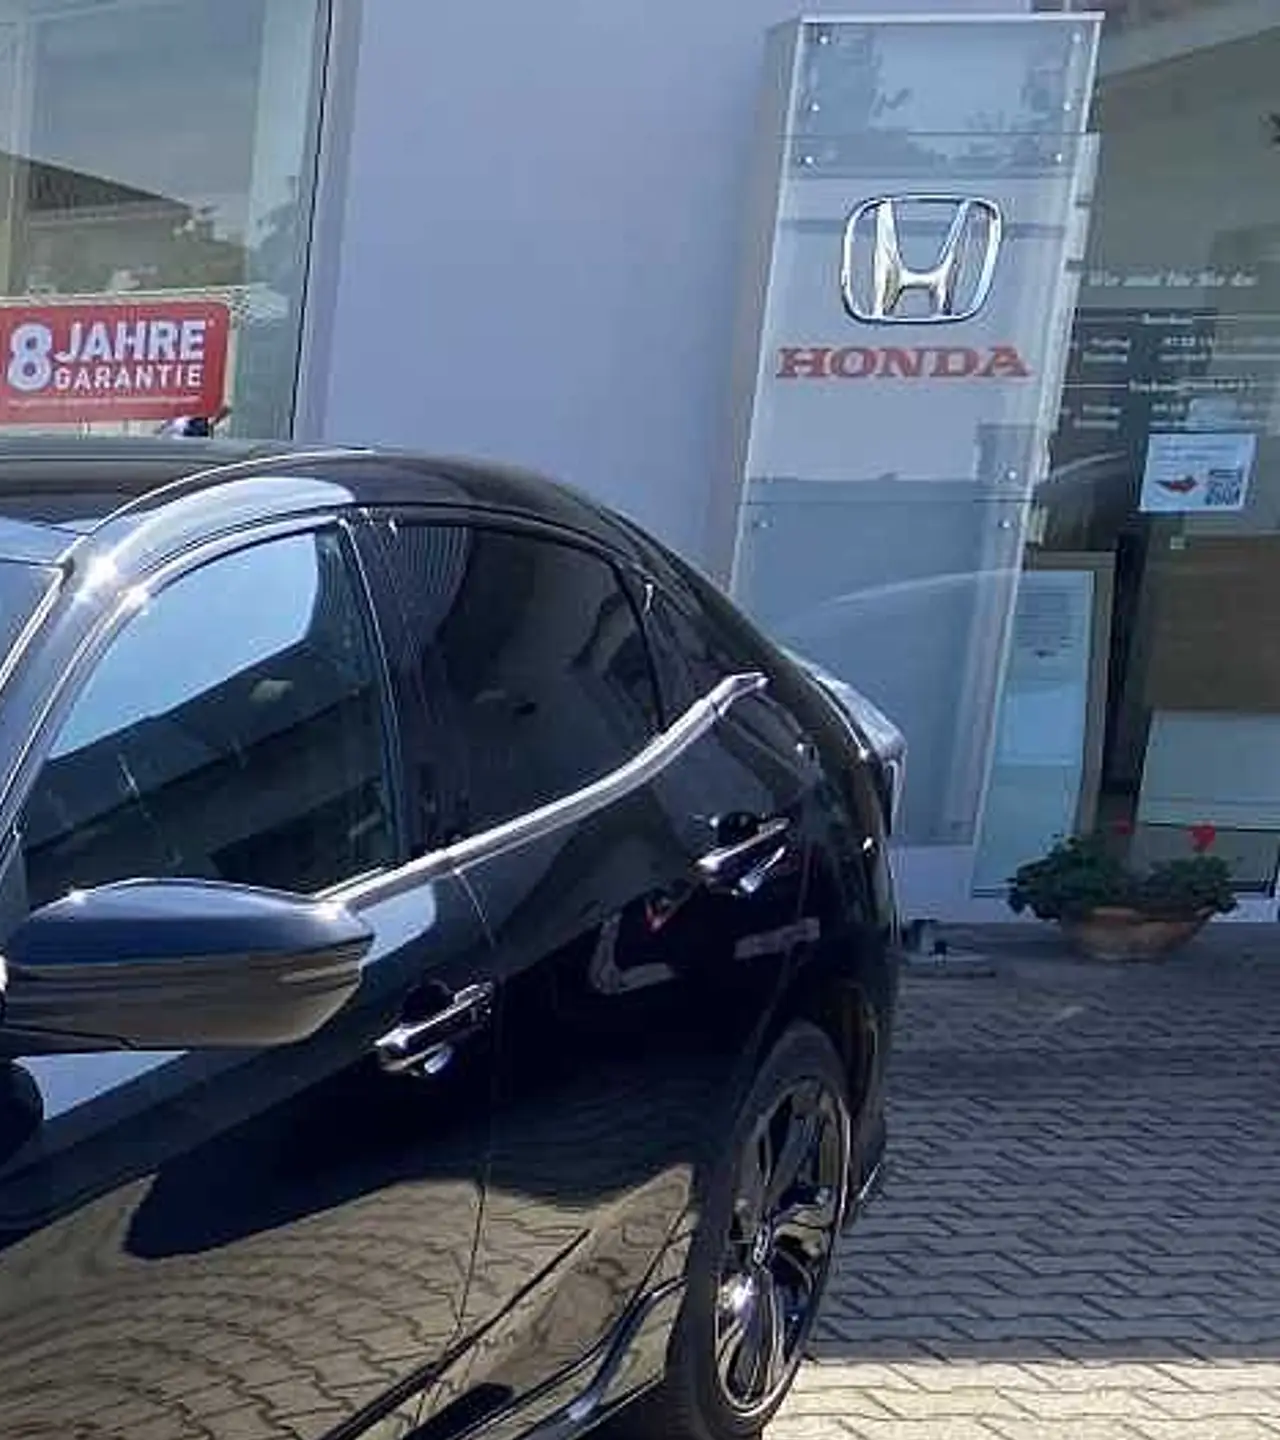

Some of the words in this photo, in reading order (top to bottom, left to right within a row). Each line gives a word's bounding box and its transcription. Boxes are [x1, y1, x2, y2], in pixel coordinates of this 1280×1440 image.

[6, 322, 53, 392] 8
[53, 318, 206, 363] JAHRE
[775, 345, 1031, 379] HONDA
[53, 365, 202, 390] GARANTIE
